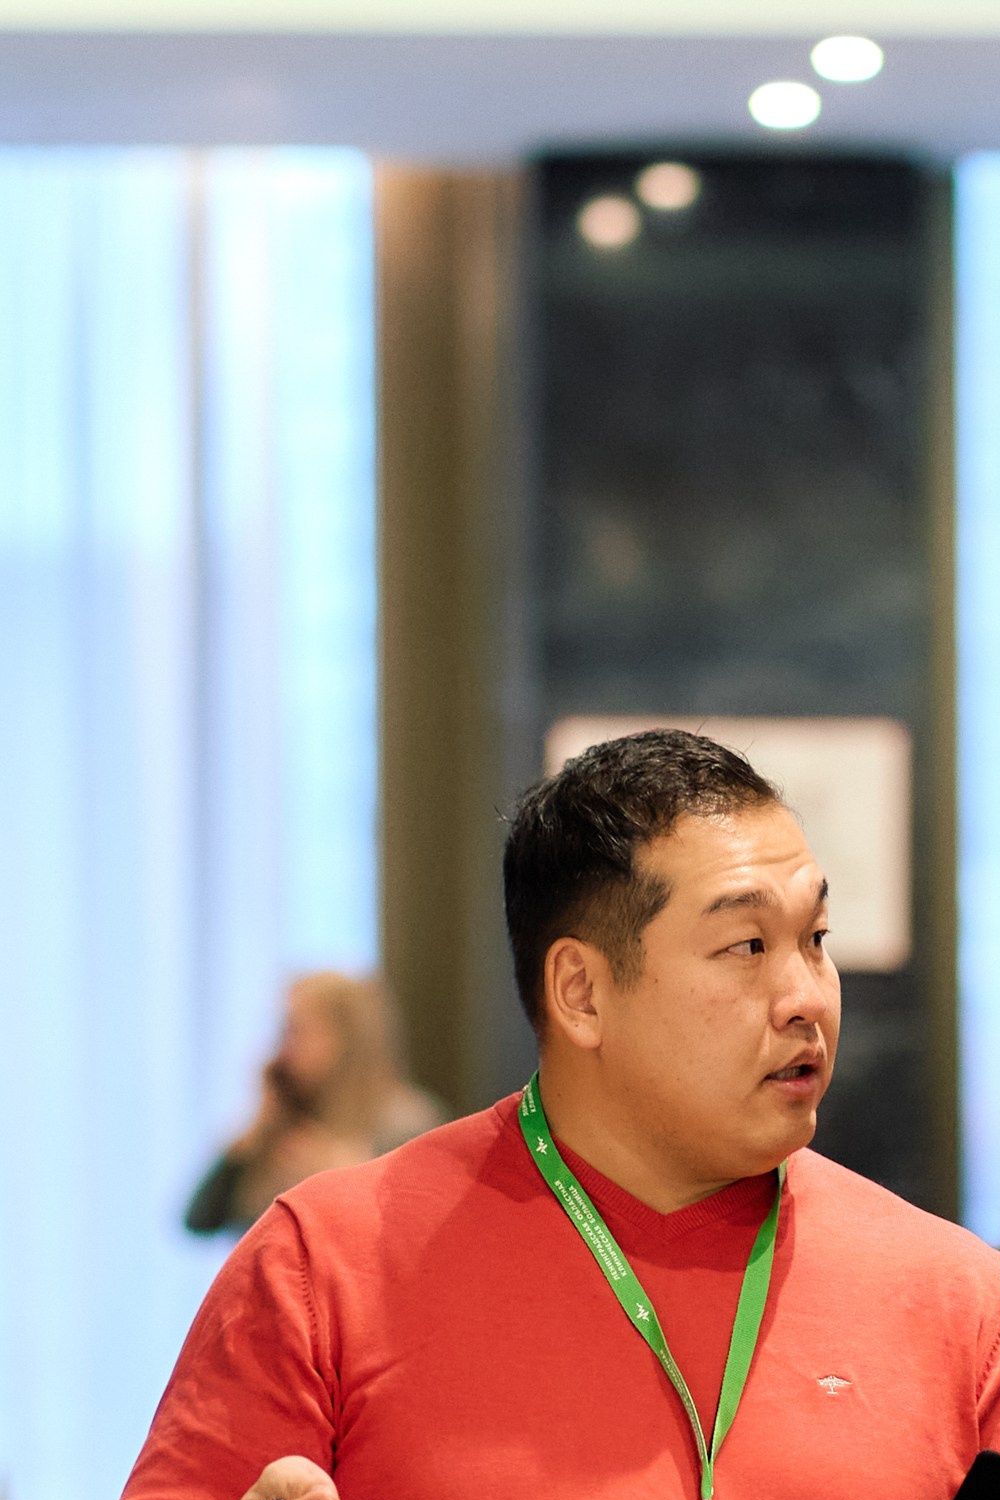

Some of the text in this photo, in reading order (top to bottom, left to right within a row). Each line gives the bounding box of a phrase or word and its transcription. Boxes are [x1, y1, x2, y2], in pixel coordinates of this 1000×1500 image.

[554, 1179, 621, 1281] ЛЕНИНГРАДСКАЯ ОБЛАСТНАЯ
[567, 1184, 628, 1277] КЛИНИЧЕСКАЯ БОЛЬНИЦА
